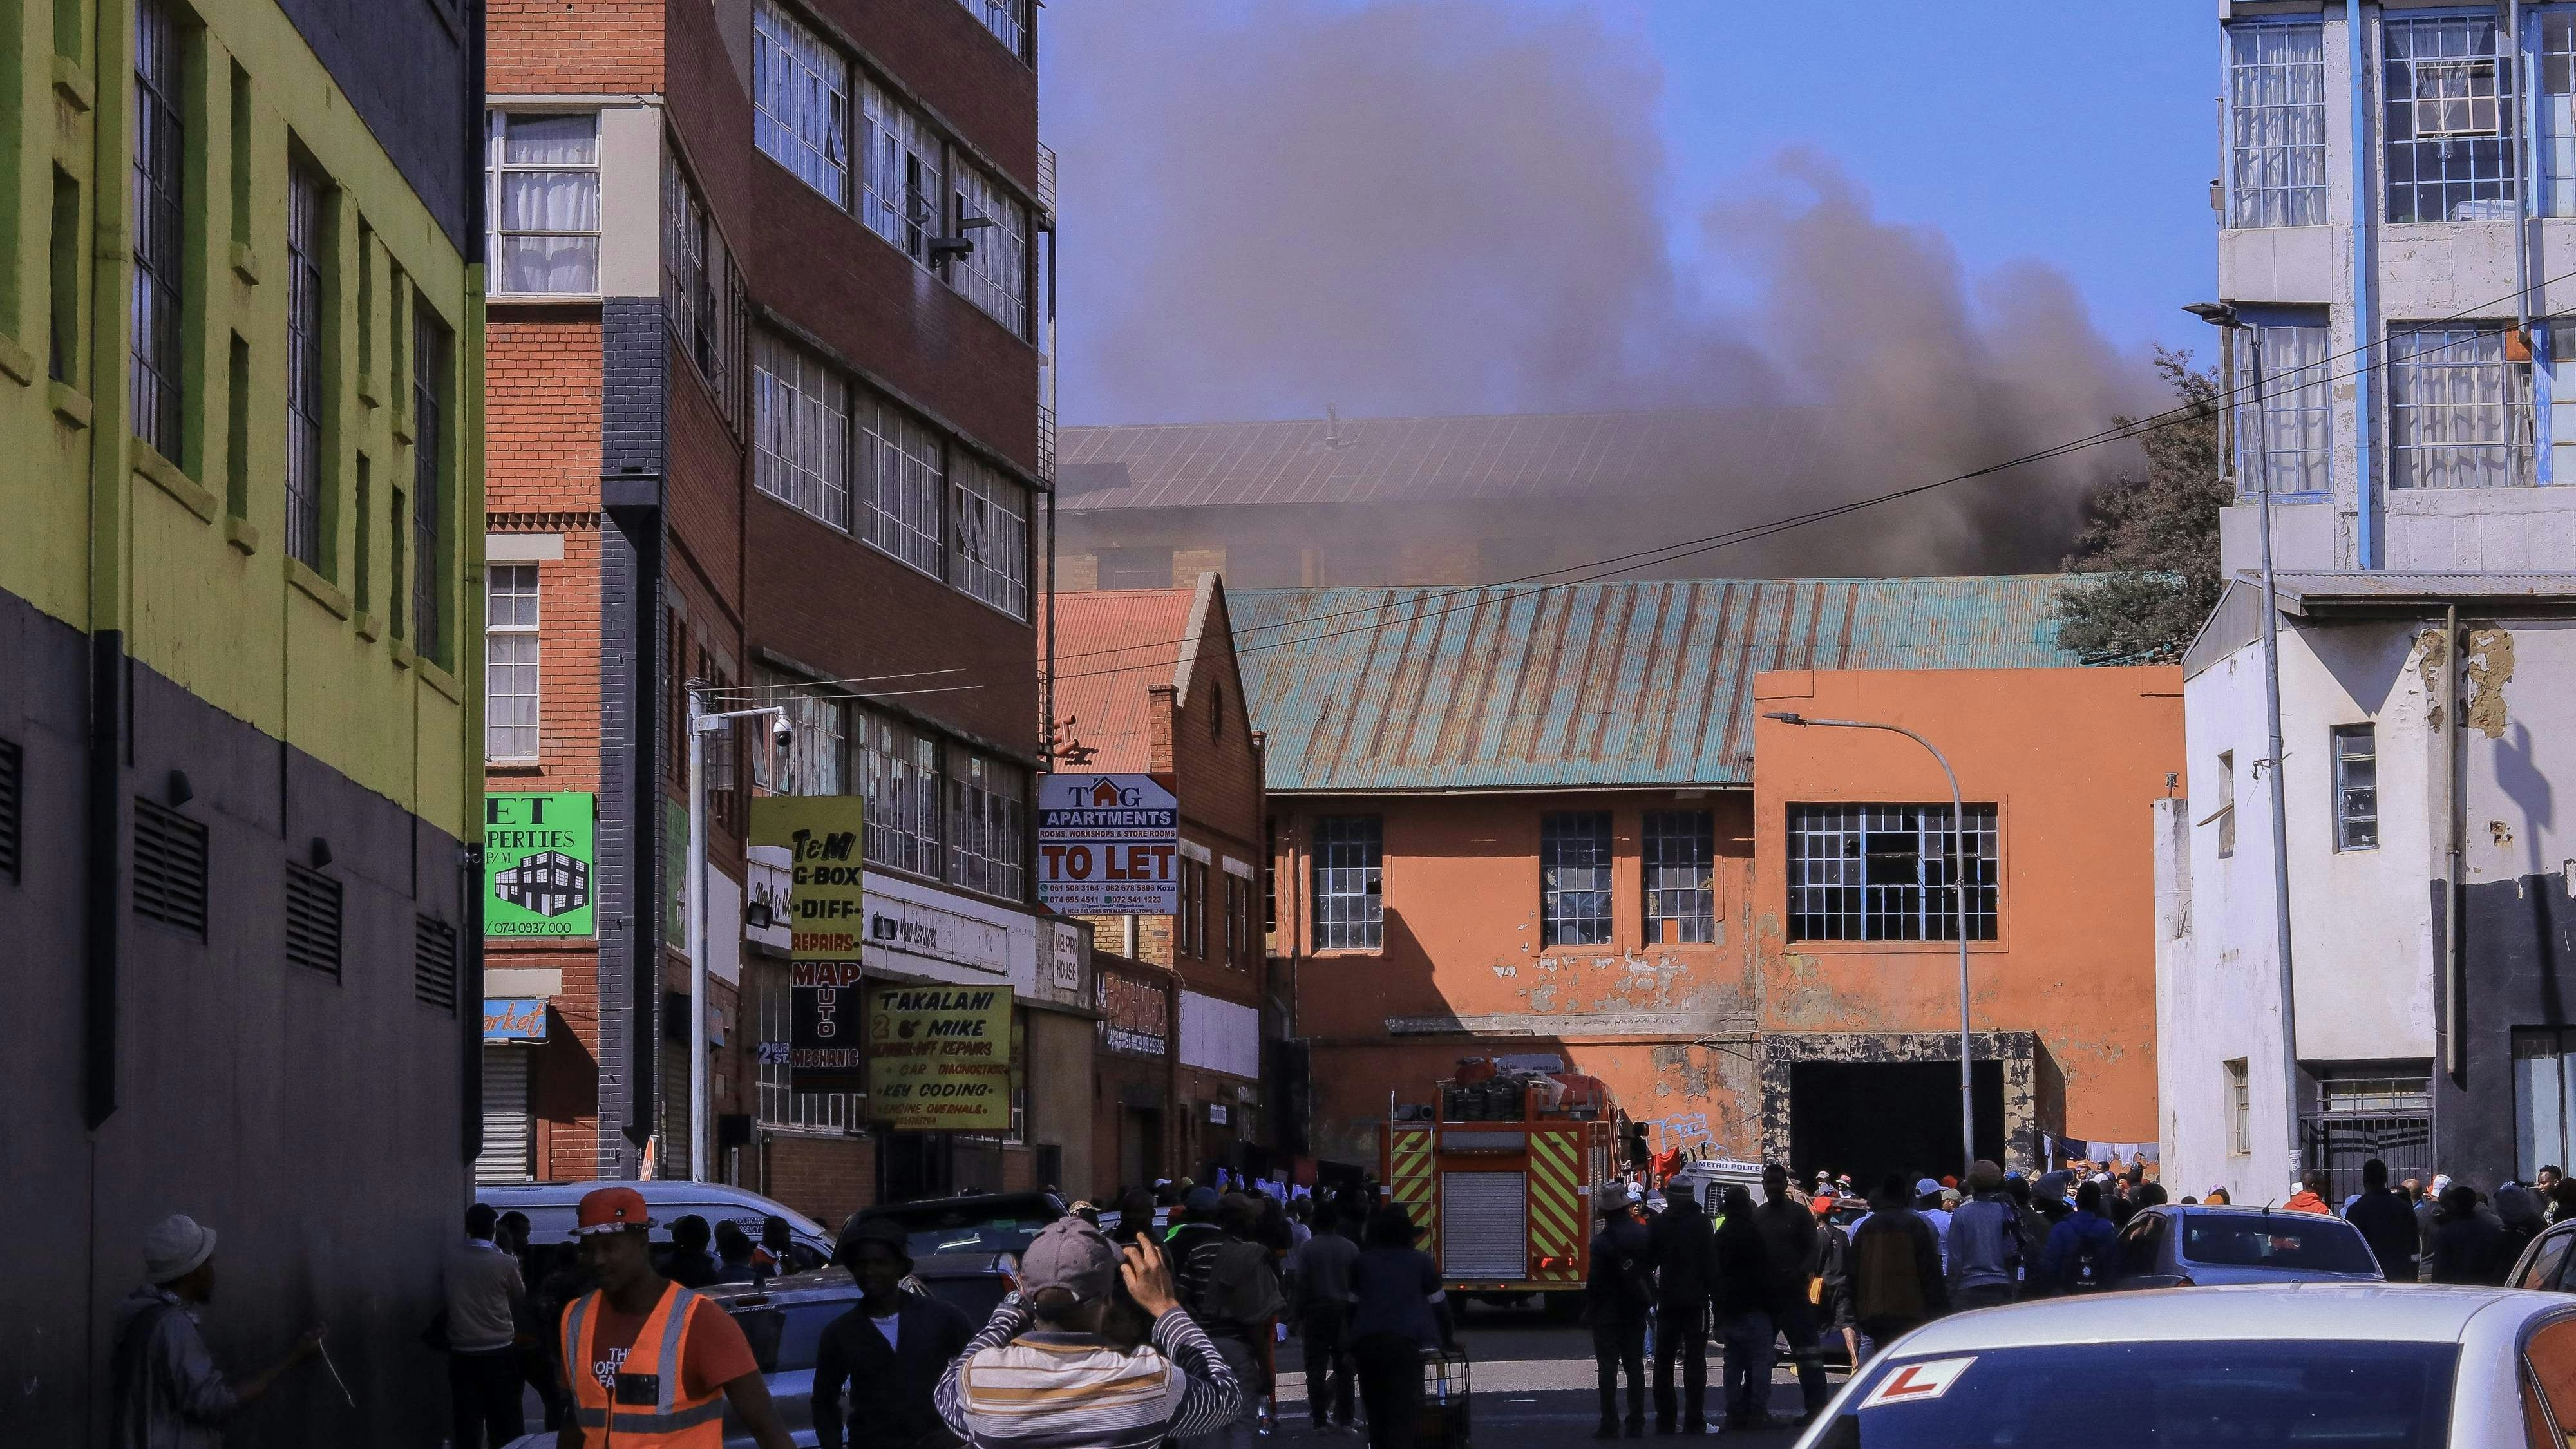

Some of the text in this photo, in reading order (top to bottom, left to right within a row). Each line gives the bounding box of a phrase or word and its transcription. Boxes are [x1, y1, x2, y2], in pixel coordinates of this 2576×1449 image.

[1047, 811, 1171, 826] APARTMENTS
[484, 831, 574, 848] PERTIES
[1040, 830, 1068, 838] ROOMS,
[486, 851, 511, 864] P/M
[1041, 845, 1175, 880] TO LET
[793, 866, 862, 886] G-BOX
[802, 899, 854, 919] DIFF
[494, 922, 516, 933] 074
[518, 922, 546, 933] 0937
[549, 922, 571, 933] 000
[792, 933, 853, 952] REPAIRS
[1054, 931, 1077, 956] MELPRO
[792, 963, 862, 987] MAP
[1057, 959, 1077, 981] HOUSE
[879, 991, 995, 1012] TAKALANI
[927, 1019, 987, 1037] MIKE
[759, 1042, 771, 1064] 2
[773, 1053, 790, 1063] ST.
[791, 1048, 858, 1068] MECHANIC
[940, 1041, 992, 1057] REPAIRS
[899, 1063, 927, 1076] CAR
[882, 1083, 989, 1097] KEY CODING
[1698, 1161, 1728, 1170] METRO
[593, 1361, 625, 1375] ORT
[1880, 1366, 1937, 1398] L
